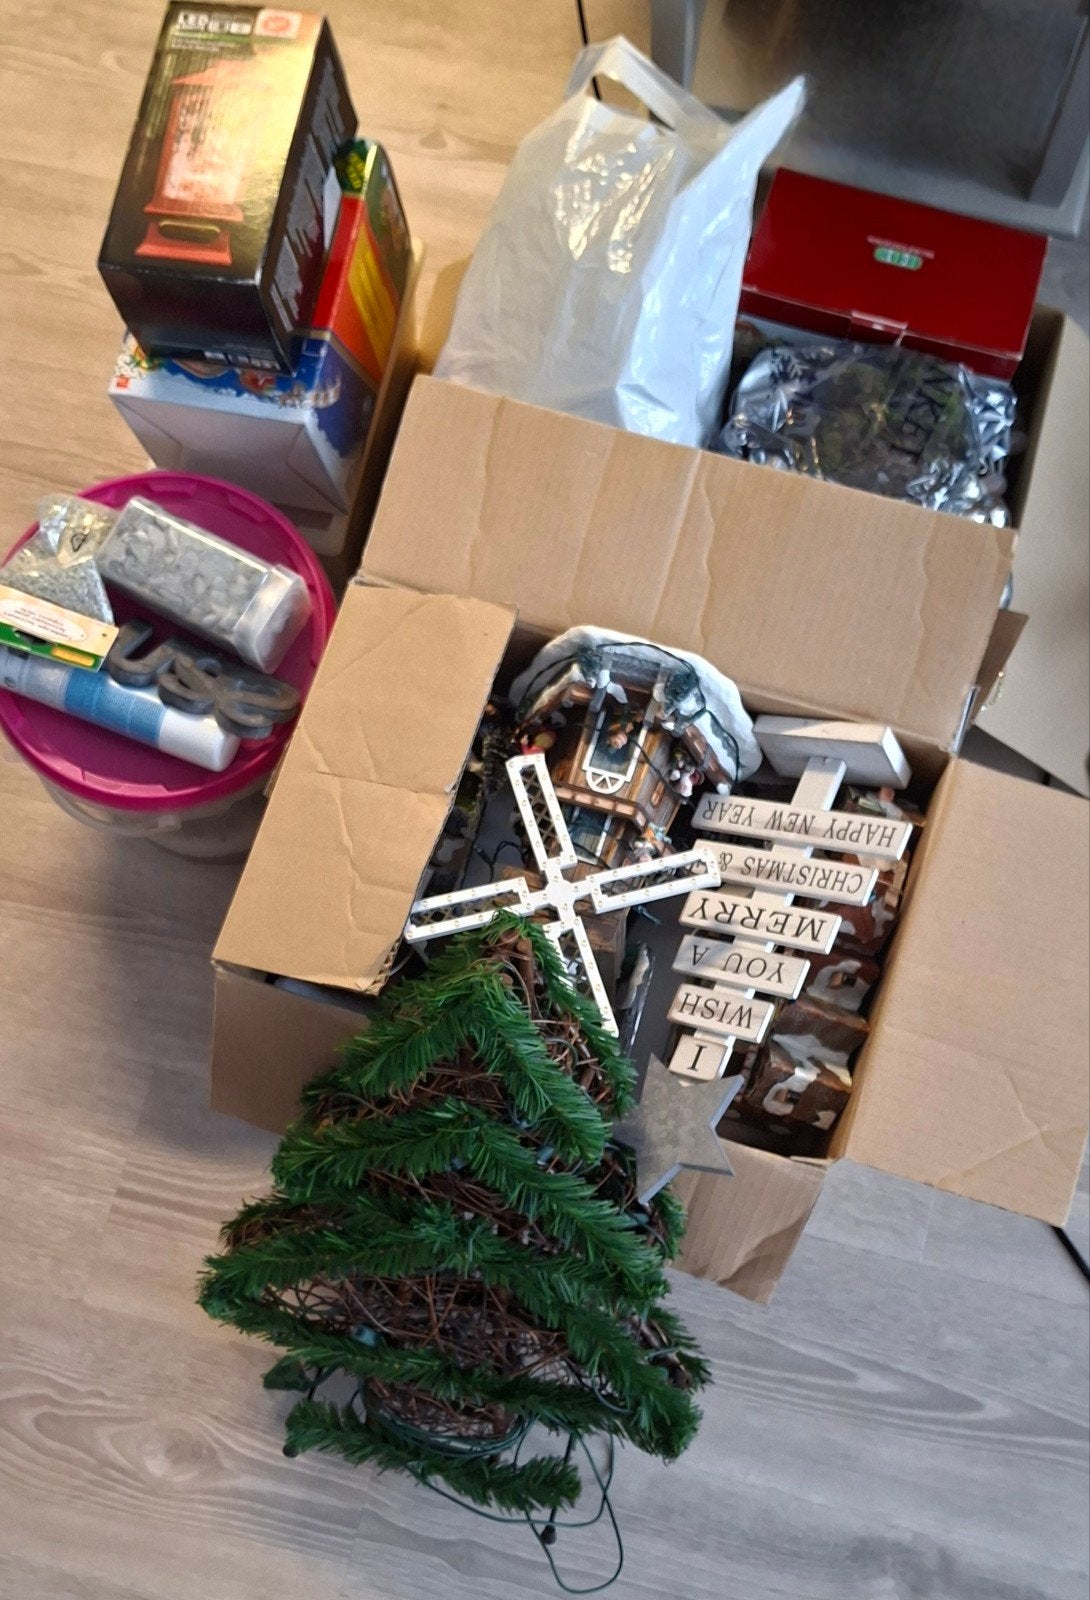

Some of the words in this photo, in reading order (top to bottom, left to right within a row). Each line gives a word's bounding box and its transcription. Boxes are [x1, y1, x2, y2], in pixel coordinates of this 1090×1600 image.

[702, 799, 755, 827] YEAR
[765, 809, 816, 836] NEW
[823, 817, 898, 848] HAPPY
[718, 852, 733, 873] &
[740, 855, 864, 894] CHRISTMAS
[688, 897, 828, 943] MERRY
[690, 944, 710, 967] A
[720, 953, 786, 985] YOU
[679, 992, 754, 1030] WISH
[687, 1044, 707, 1072] I
